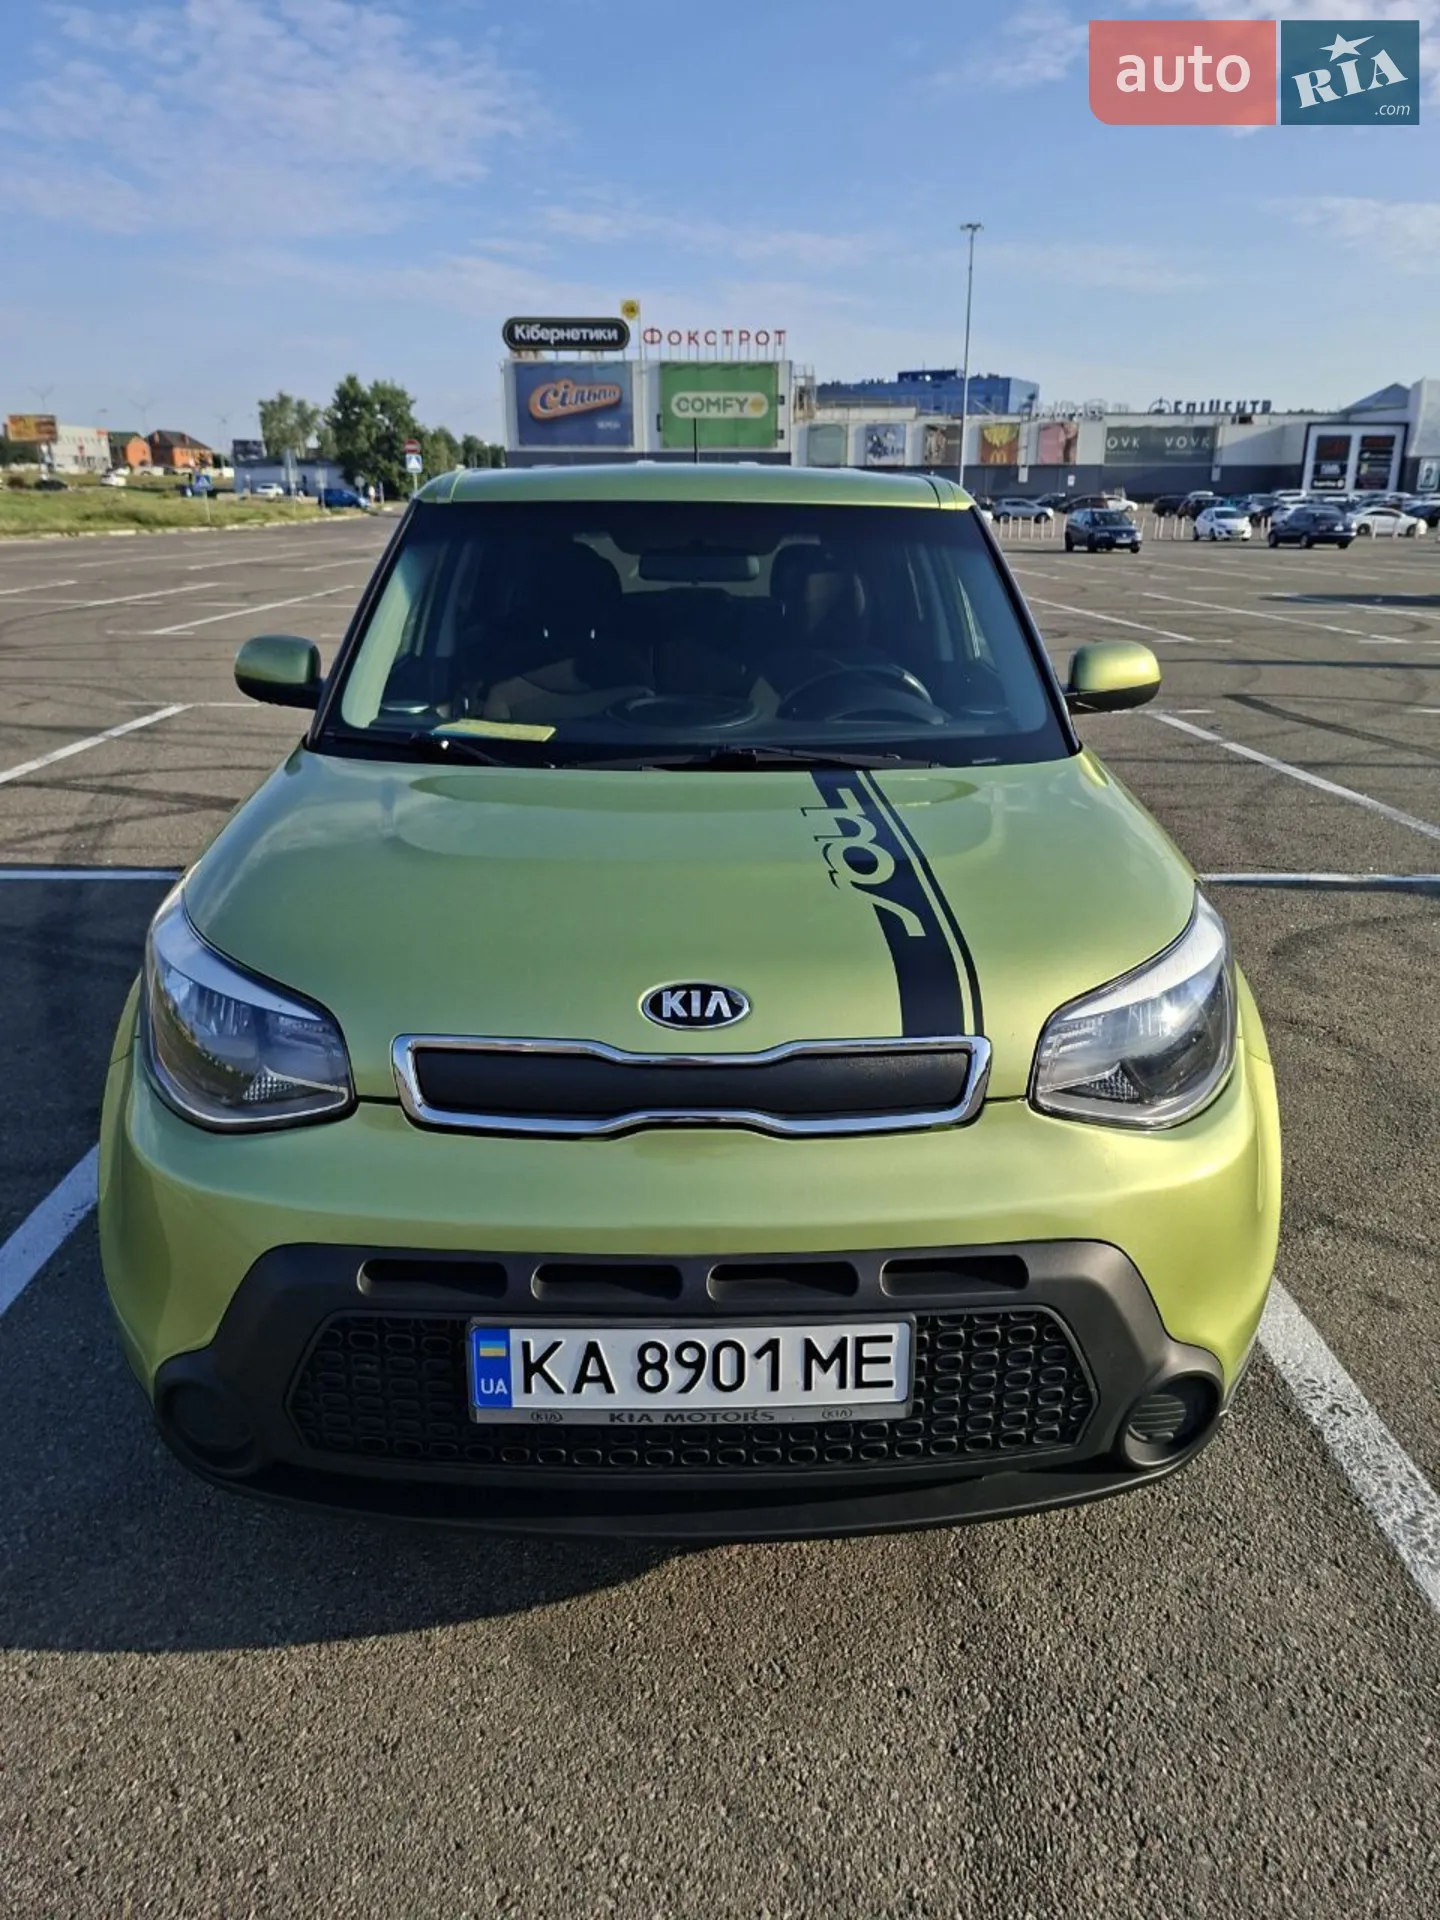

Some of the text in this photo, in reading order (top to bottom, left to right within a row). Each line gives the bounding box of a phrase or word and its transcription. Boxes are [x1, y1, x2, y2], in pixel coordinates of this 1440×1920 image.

[514, 324, 618, 345] Кібернетики
[643, 328, 786, 346] ФОКСТРОТ
[675, 396, 748, 413] COMFY
[1164, 436, 1210, 449] VOVK
[661, 990, 734, 1019] KIA
[521, 1333, 895, 1396] KA 8901 ME
[480, 1377, 508, 1395] UA
[608, 1410, 775, 1423] KIA MOTORS
